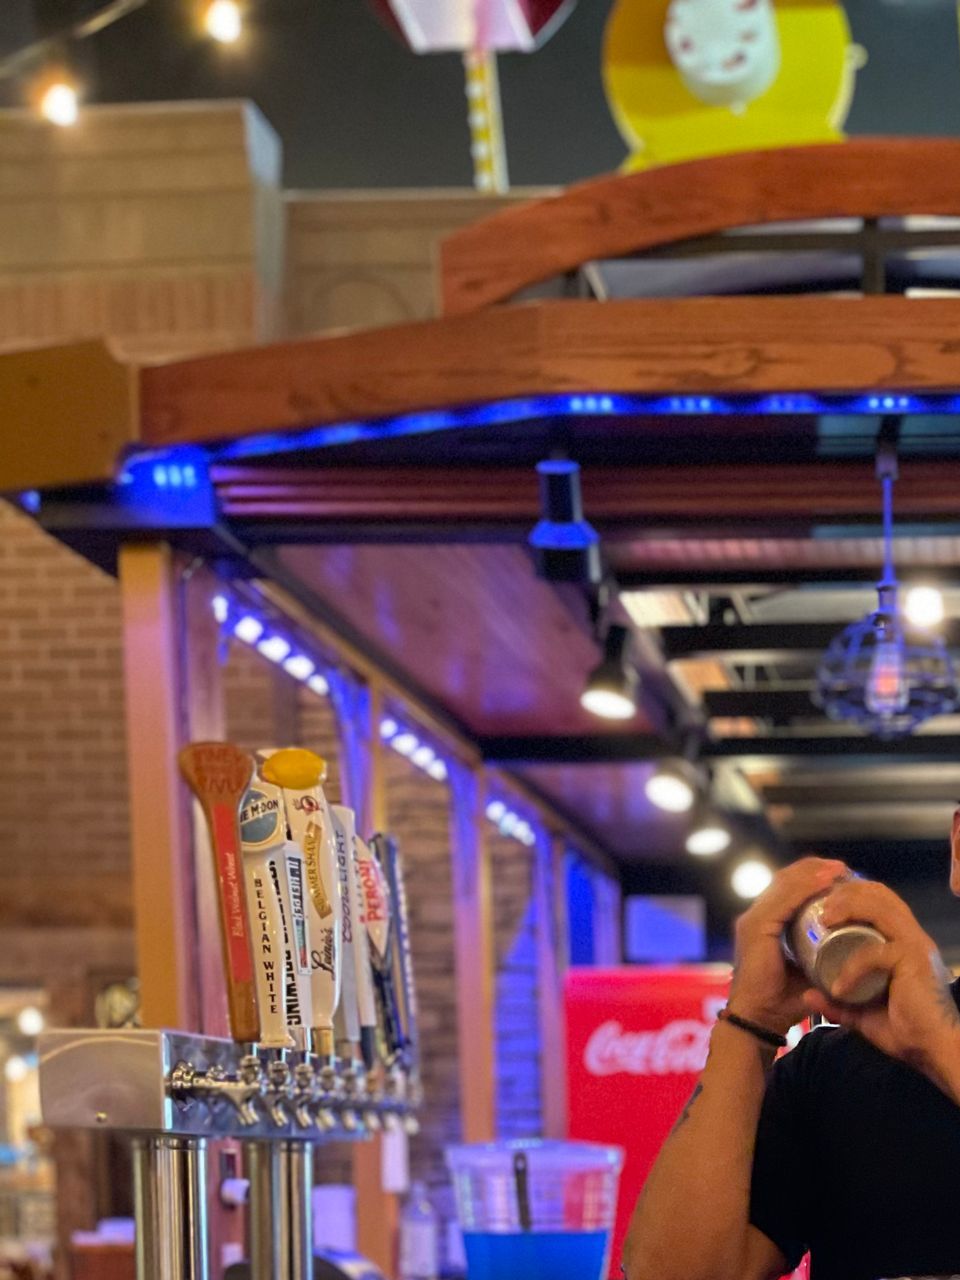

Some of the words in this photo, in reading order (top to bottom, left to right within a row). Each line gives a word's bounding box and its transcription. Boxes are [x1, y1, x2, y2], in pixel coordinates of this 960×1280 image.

[335, 830, 348, 883] LIGHT
[254, 878, 272, 955] BELGIAN
[262, 960, 279, 1014] WHITE
